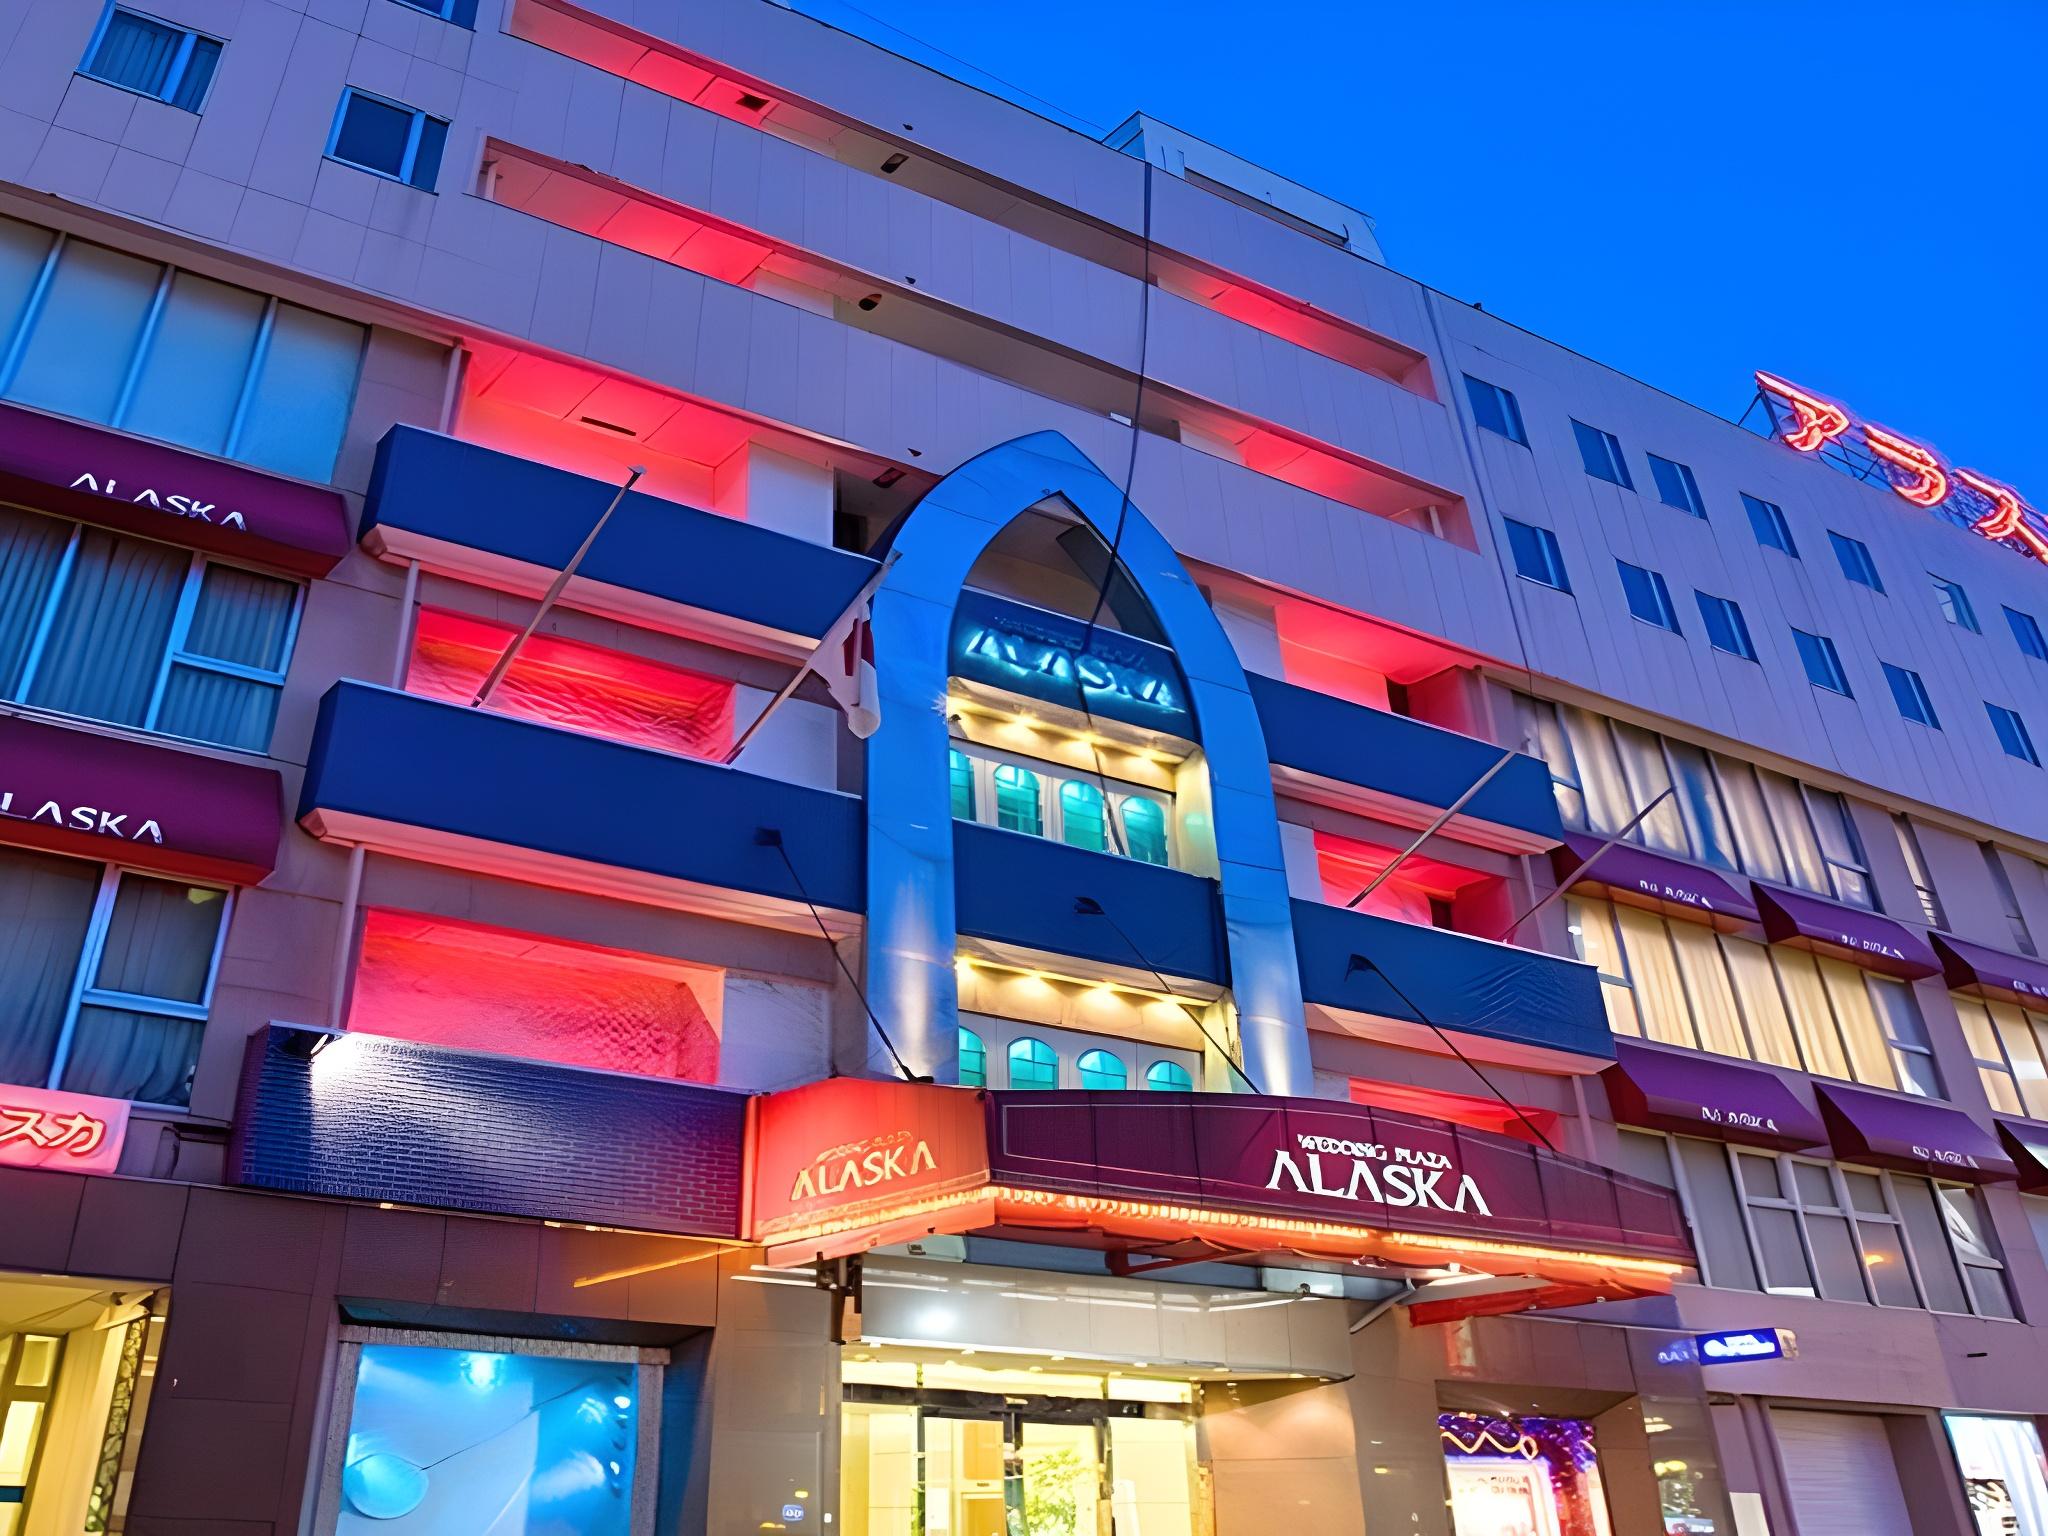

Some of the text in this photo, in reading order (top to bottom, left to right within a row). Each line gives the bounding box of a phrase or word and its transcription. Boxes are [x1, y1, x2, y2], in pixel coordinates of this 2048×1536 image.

[0, 1104, 107, 1157] スカ
[790, 1140, 937, 1201] ALASKA
[1265, 1149, 1493, 1217] ALASKA
